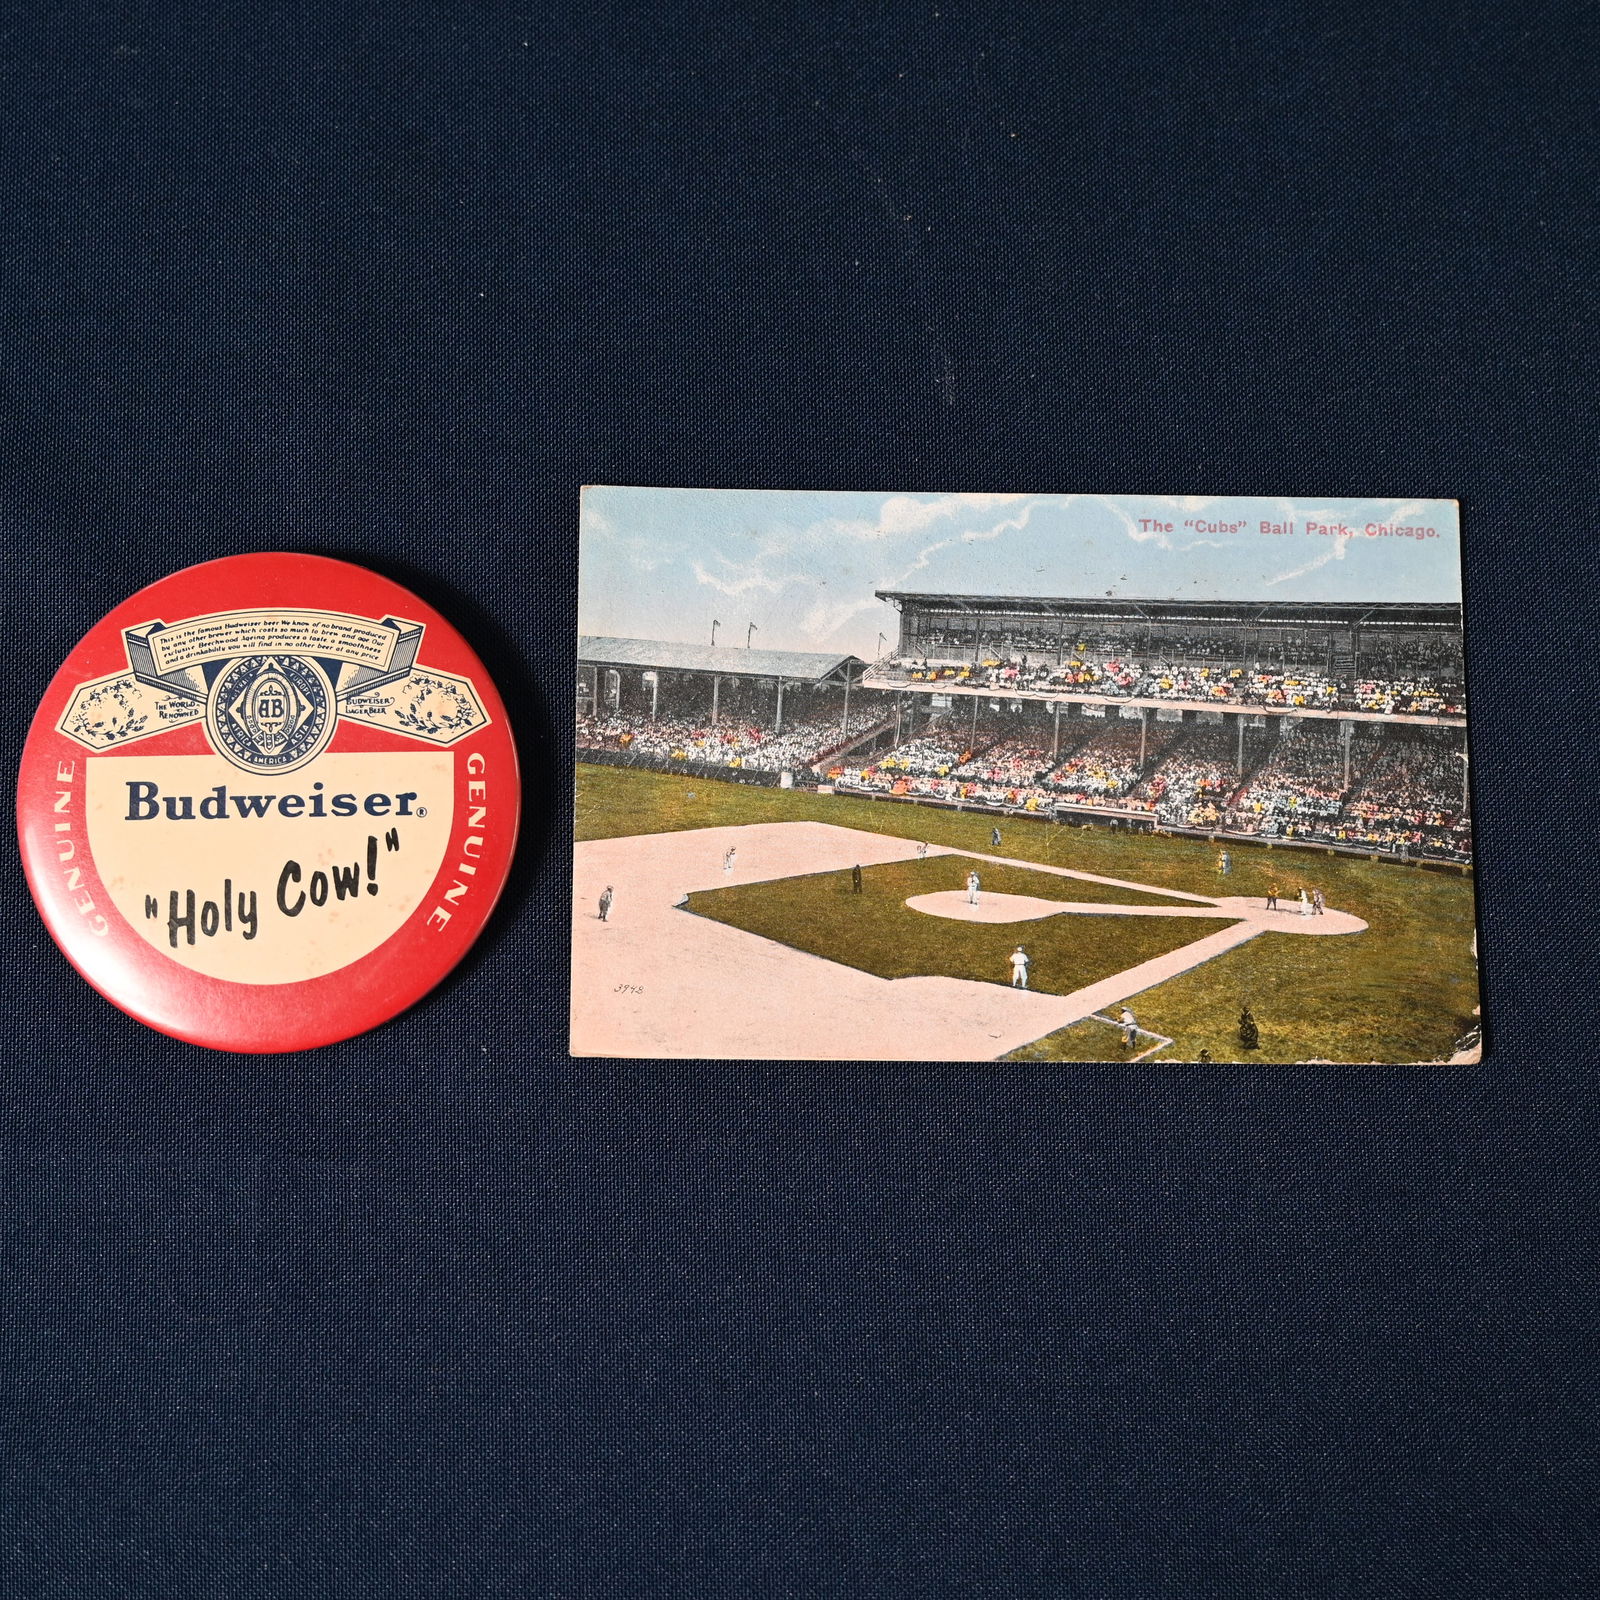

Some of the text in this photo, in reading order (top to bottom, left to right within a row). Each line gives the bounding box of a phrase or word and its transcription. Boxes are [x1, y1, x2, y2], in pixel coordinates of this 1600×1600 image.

[1138, 518, 1441, 540] The “Cubs” Ball Park, Chicago.
[188, 635, 206, 643] other
[208, 631, 232, 639] brewer
[342, 632, 356, 640] and
[372, 638, 384, 646] Our
[198, 626, 223, 635] famous
[224, 621, 261, 630] Budweiser
[331, 623, 352, 632] brand
[354, 628, 388, 640] produced
[164, 645, 195, 658] exclusive
[198, 636, 238, 648] Beechwood
[338, 640, 382, 654] smoothness
[166, 656, 178, 664] and
[186, 646, 226, 658] drinkability
[346, 648, 360, 656] any
[360, 652, 379, 660] price
[154, 702, 166, 710] THE
[346, 697, 391, 705] BUDWEISER
[159, 709, 199, 719] RENOWNED
[231, 723, 252, 747] AFRICA
[291, 724, 310, 745] ASIA
[253, 756, 287, 764] AMERICA
[53, 760, 109, 937] GENUINE
[426, 752, 487, 932] GENUINE
